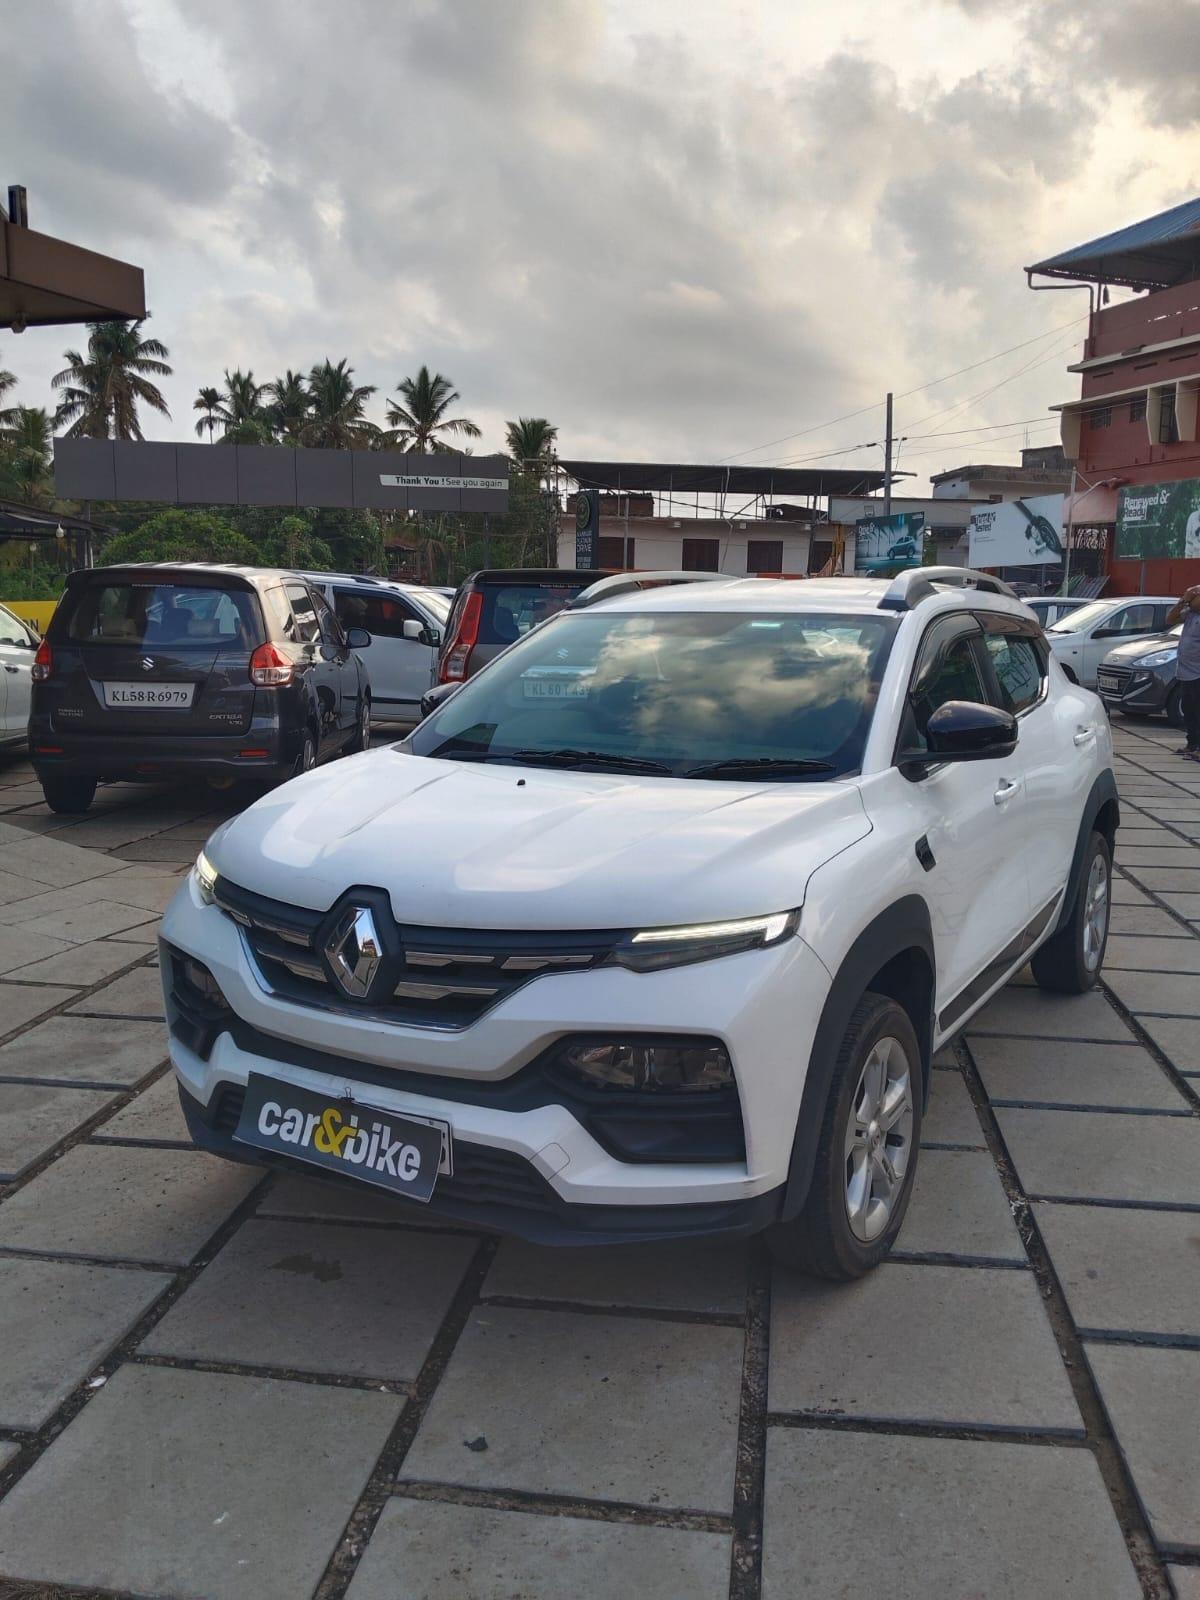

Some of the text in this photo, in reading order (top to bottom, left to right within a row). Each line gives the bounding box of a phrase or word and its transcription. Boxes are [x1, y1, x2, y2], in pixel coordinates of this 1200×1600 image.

[395, 476, 421, 485] Thank
[423, 477, 440, 486] You
[445, 477, 461, 486] See
[462, 479, 479, 488] you
[479, 479, 503, 489] again
[1124, 489, 1171, 508] Renewed &
[1125, 507, 1147, 521] Ready
[576, 543, 592, 553] DRIVE
[257, 1101, 422, 1182] car&bike
